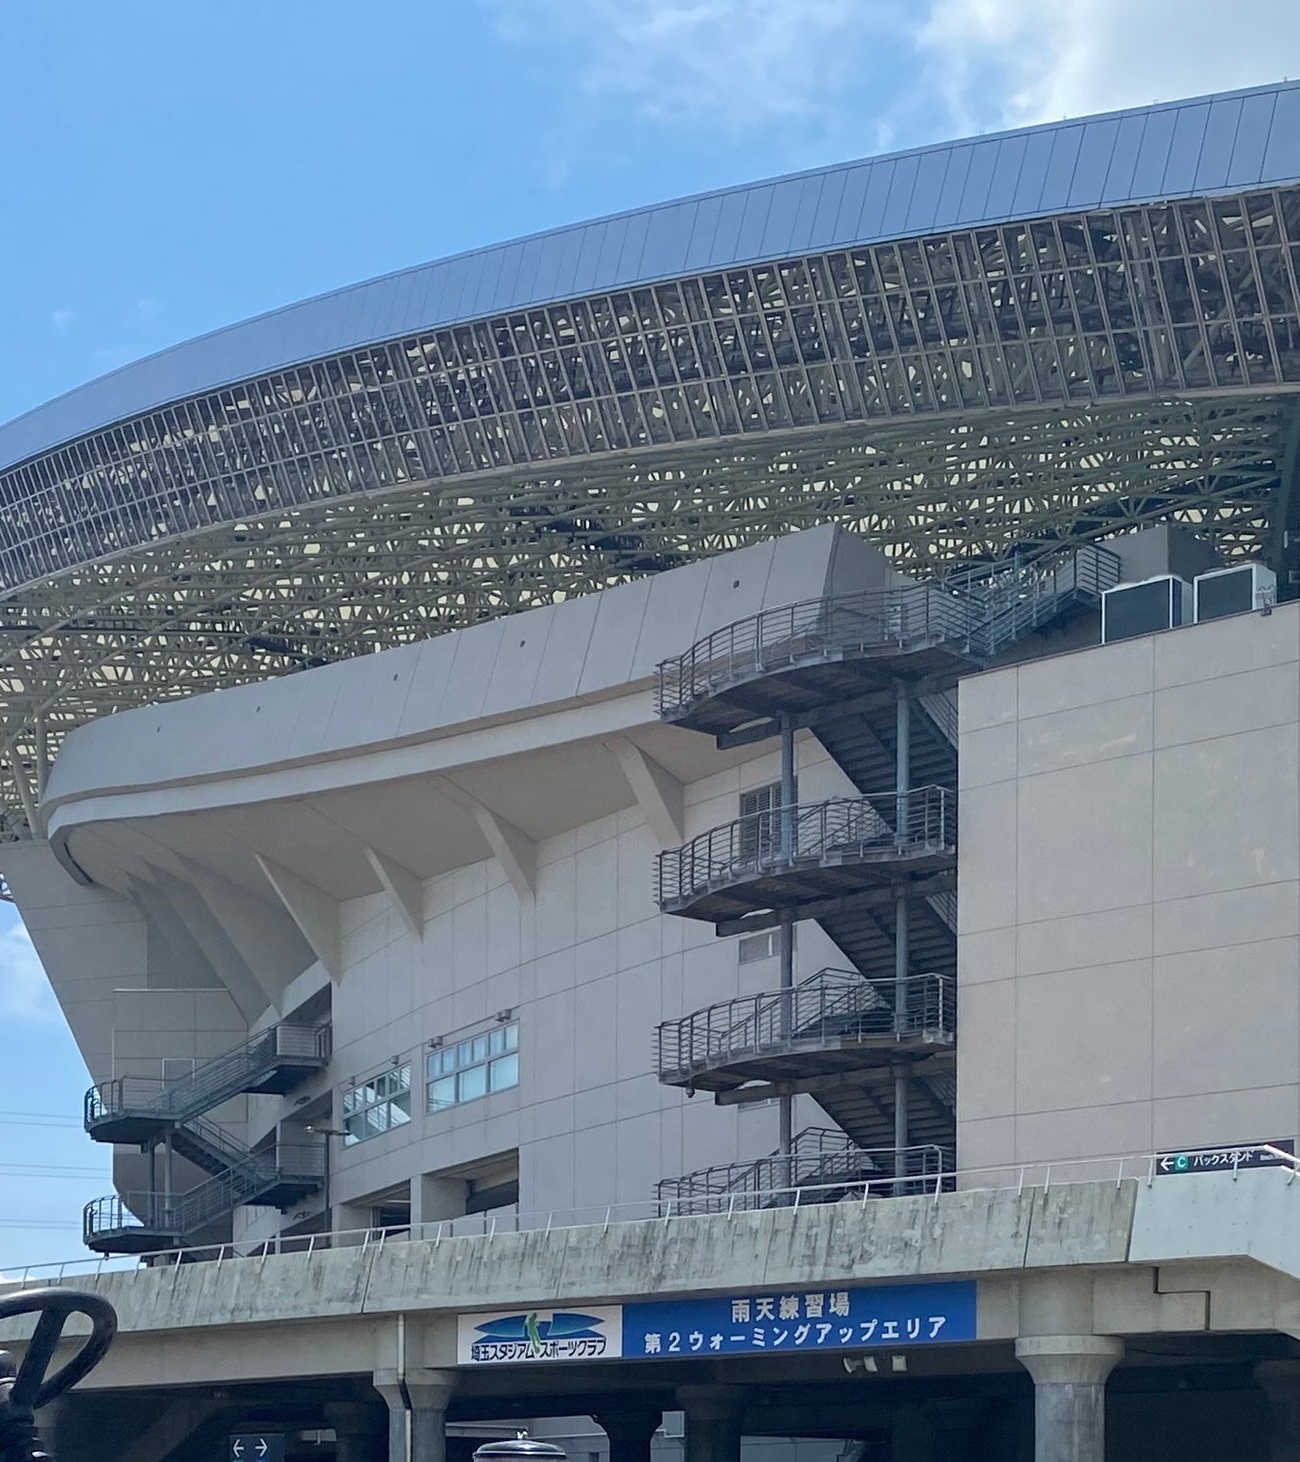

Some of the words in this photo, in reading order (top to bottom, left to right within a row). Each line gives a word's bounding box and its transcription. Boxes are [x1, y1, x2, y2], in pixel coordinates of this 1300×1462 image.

[1177, 1156, 1187, 1168] C
[731, 1292, 851, 1323] 雨天練習場
